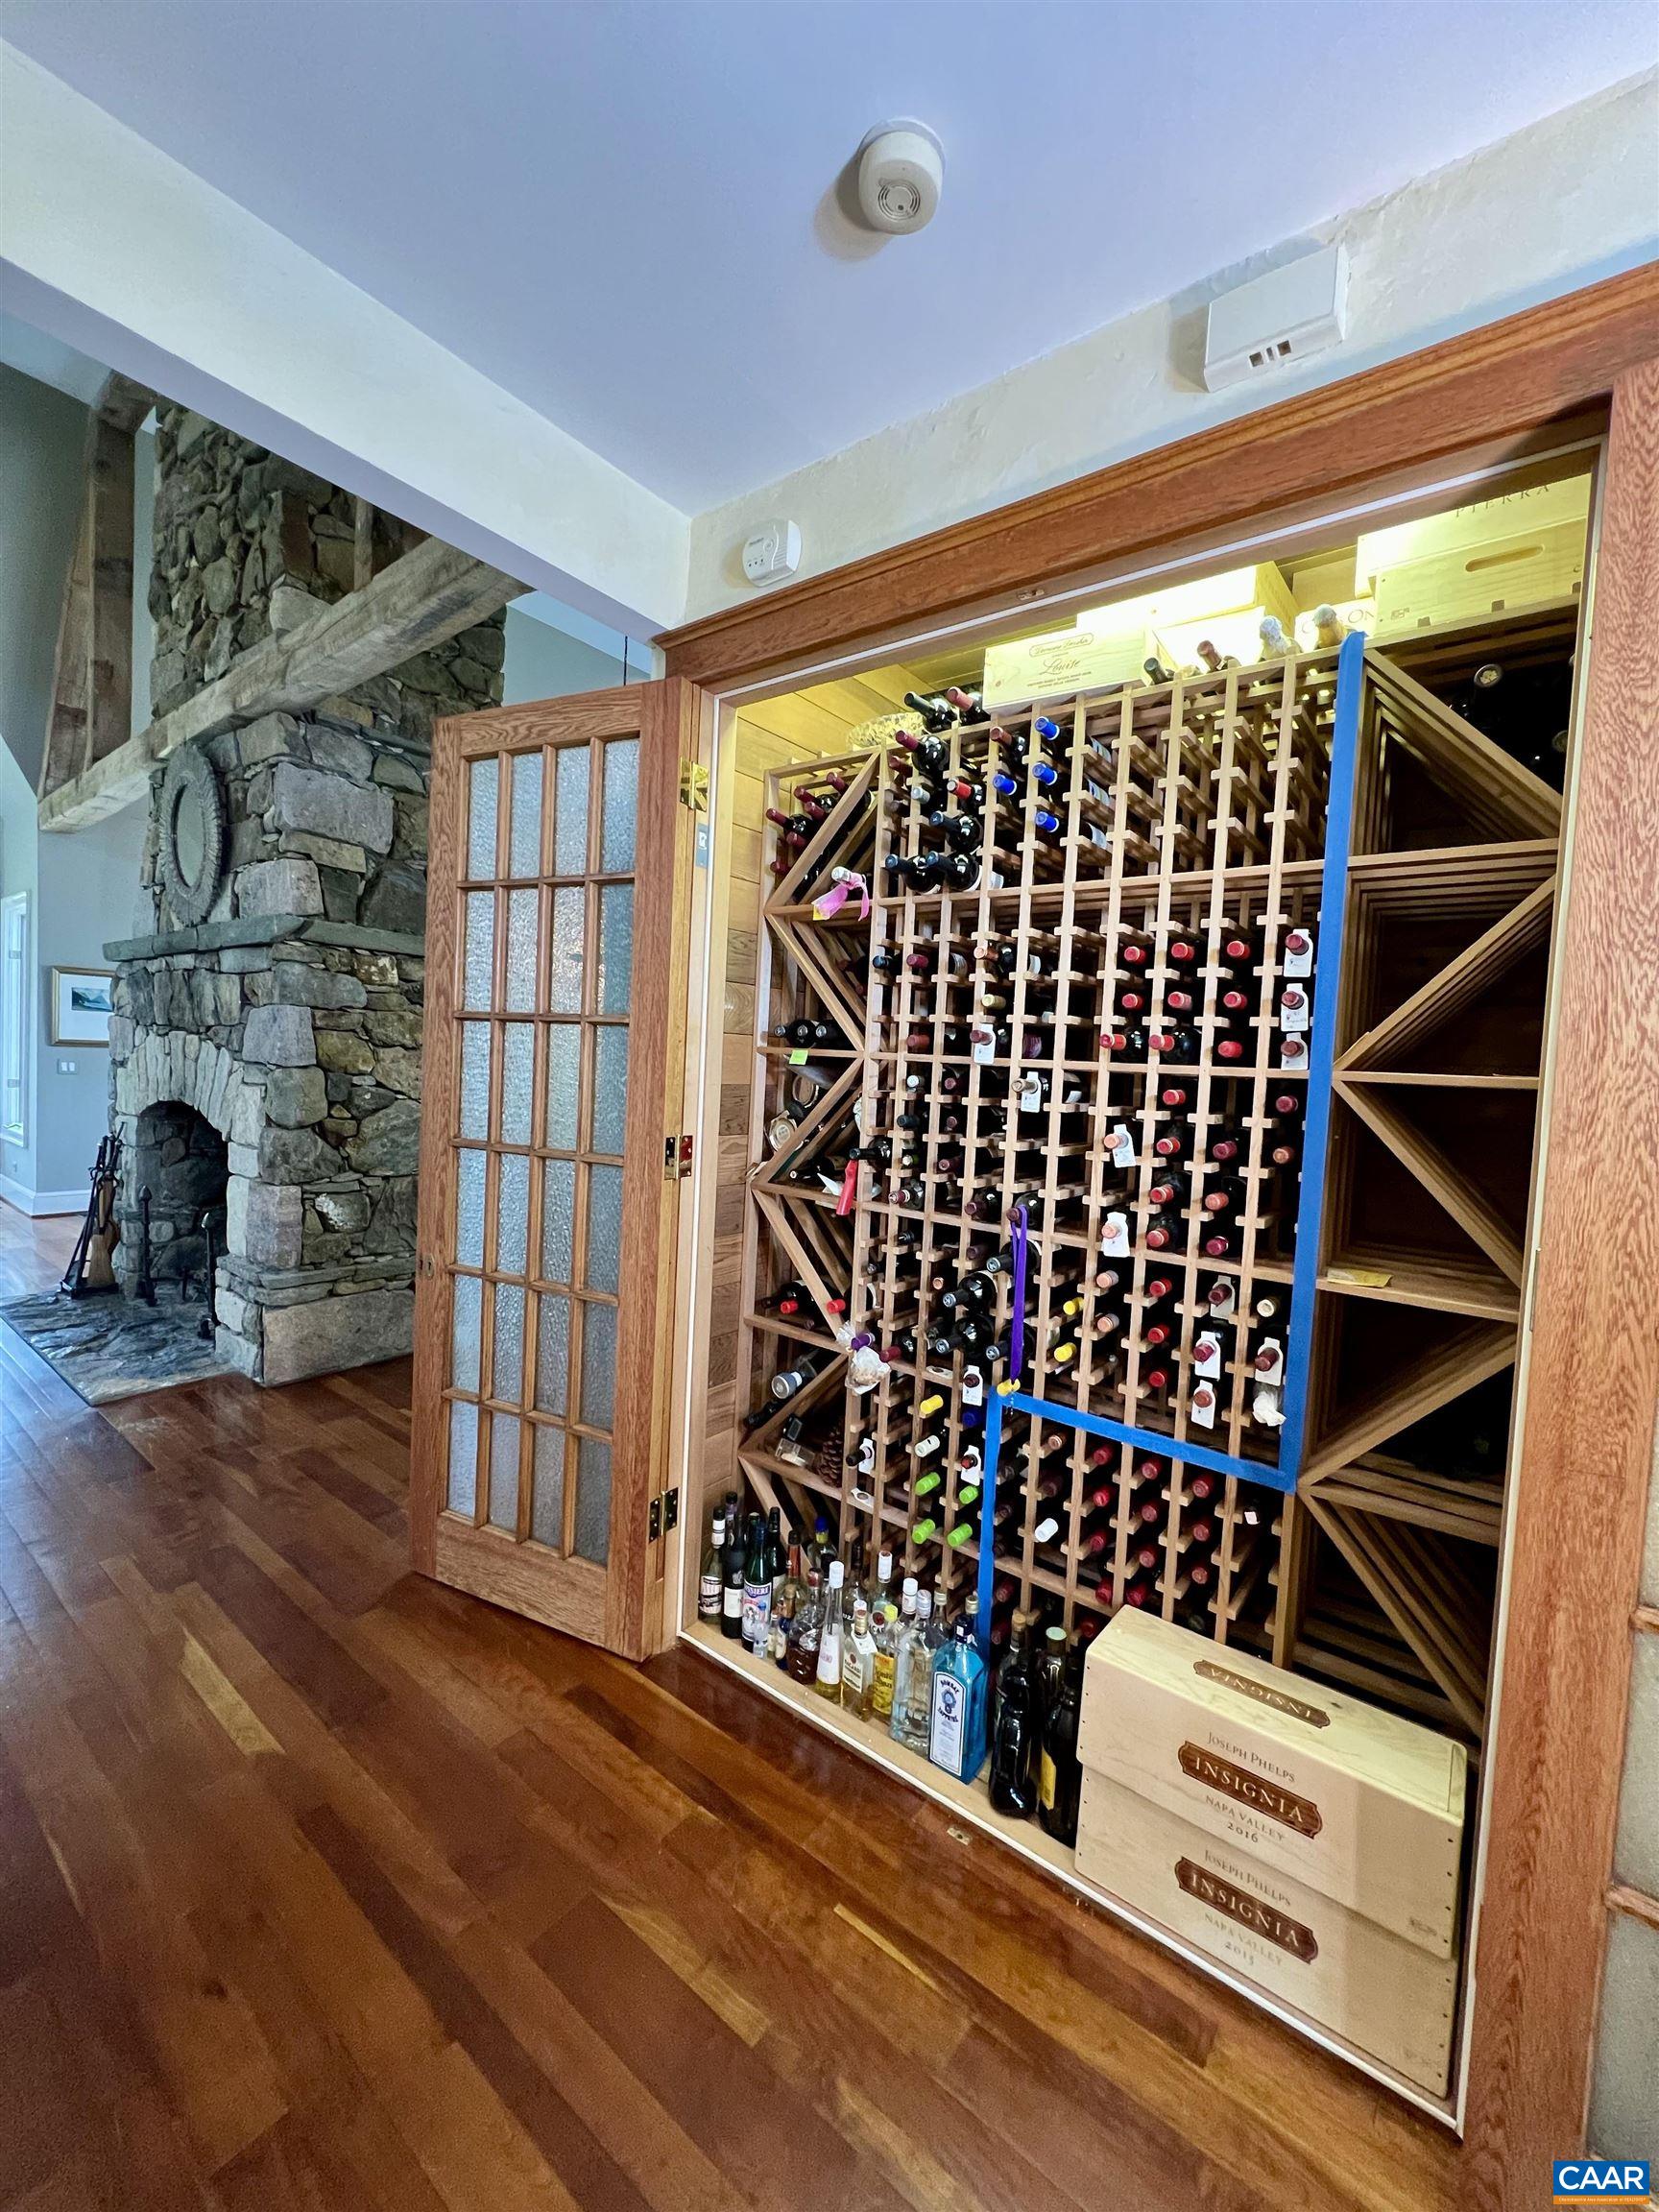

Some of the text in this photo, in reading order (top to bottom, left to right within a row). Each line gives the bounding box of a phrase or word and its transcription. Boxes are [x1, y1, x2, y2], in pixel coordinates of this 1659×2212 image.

[1039, 658, 1081, 675] Louise
[1210, 1668, 1311, 1718] INSIGNIA
[1195, 1757, 1303, 1822] INSIGNIA
[1205, 1795, 1285, 1841] NAPA VALLEY
[1227, 1824, 1259, 1843] 2016
[1190, 1873, 1299, 1947] INSIGNIA
[1204, 1912, 1282, 1965] NAPA VALLEY
